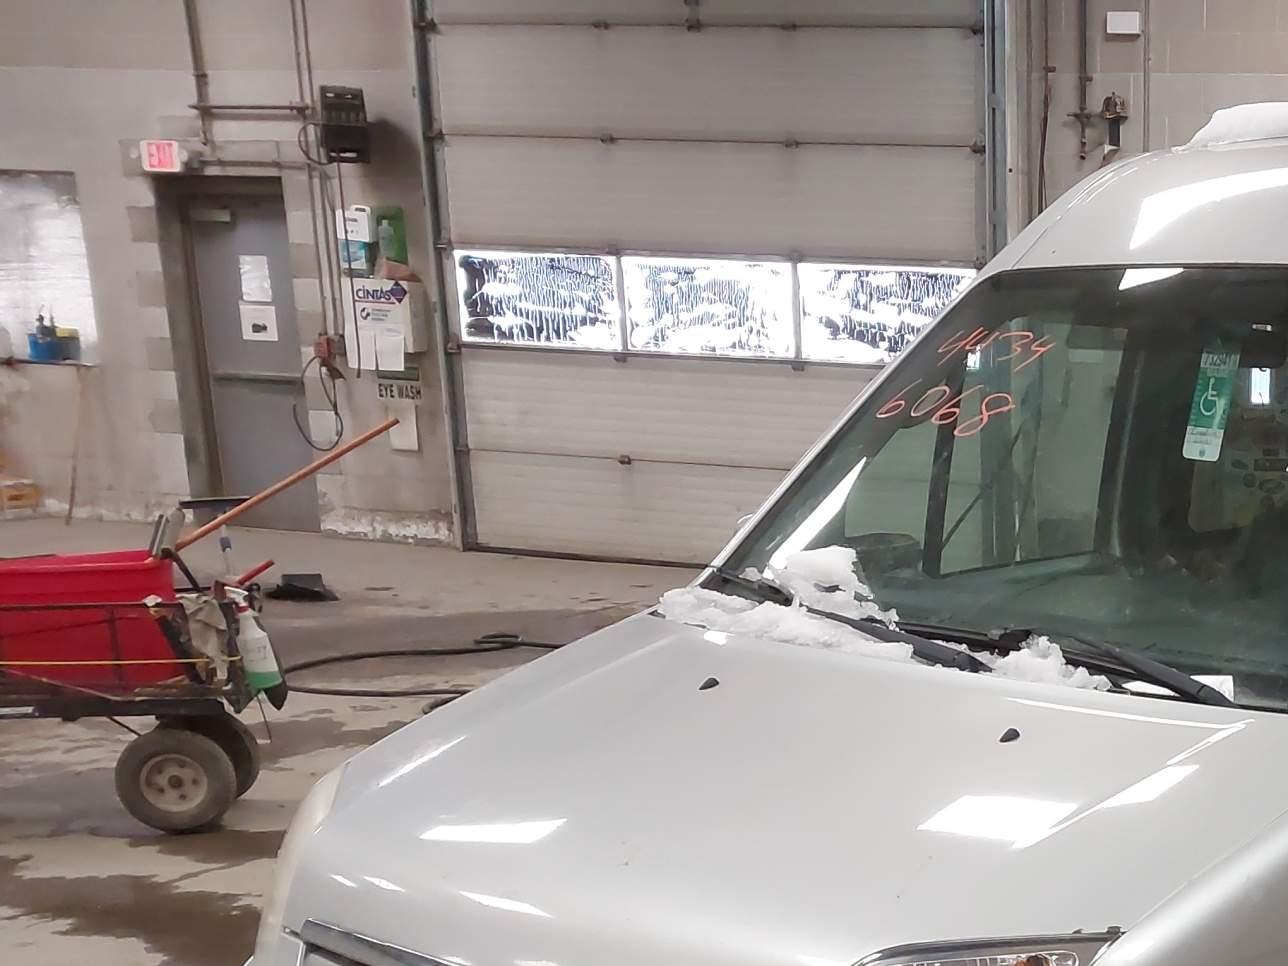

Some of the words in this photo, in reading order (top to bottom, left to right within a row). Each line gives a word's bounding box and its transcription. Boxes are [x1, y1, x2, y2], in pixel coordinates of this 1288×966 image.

[378, 383, 394, 398] EYE
[398, 385, 422, 400] WASH
[876, 379, 1016, 437] 6068
